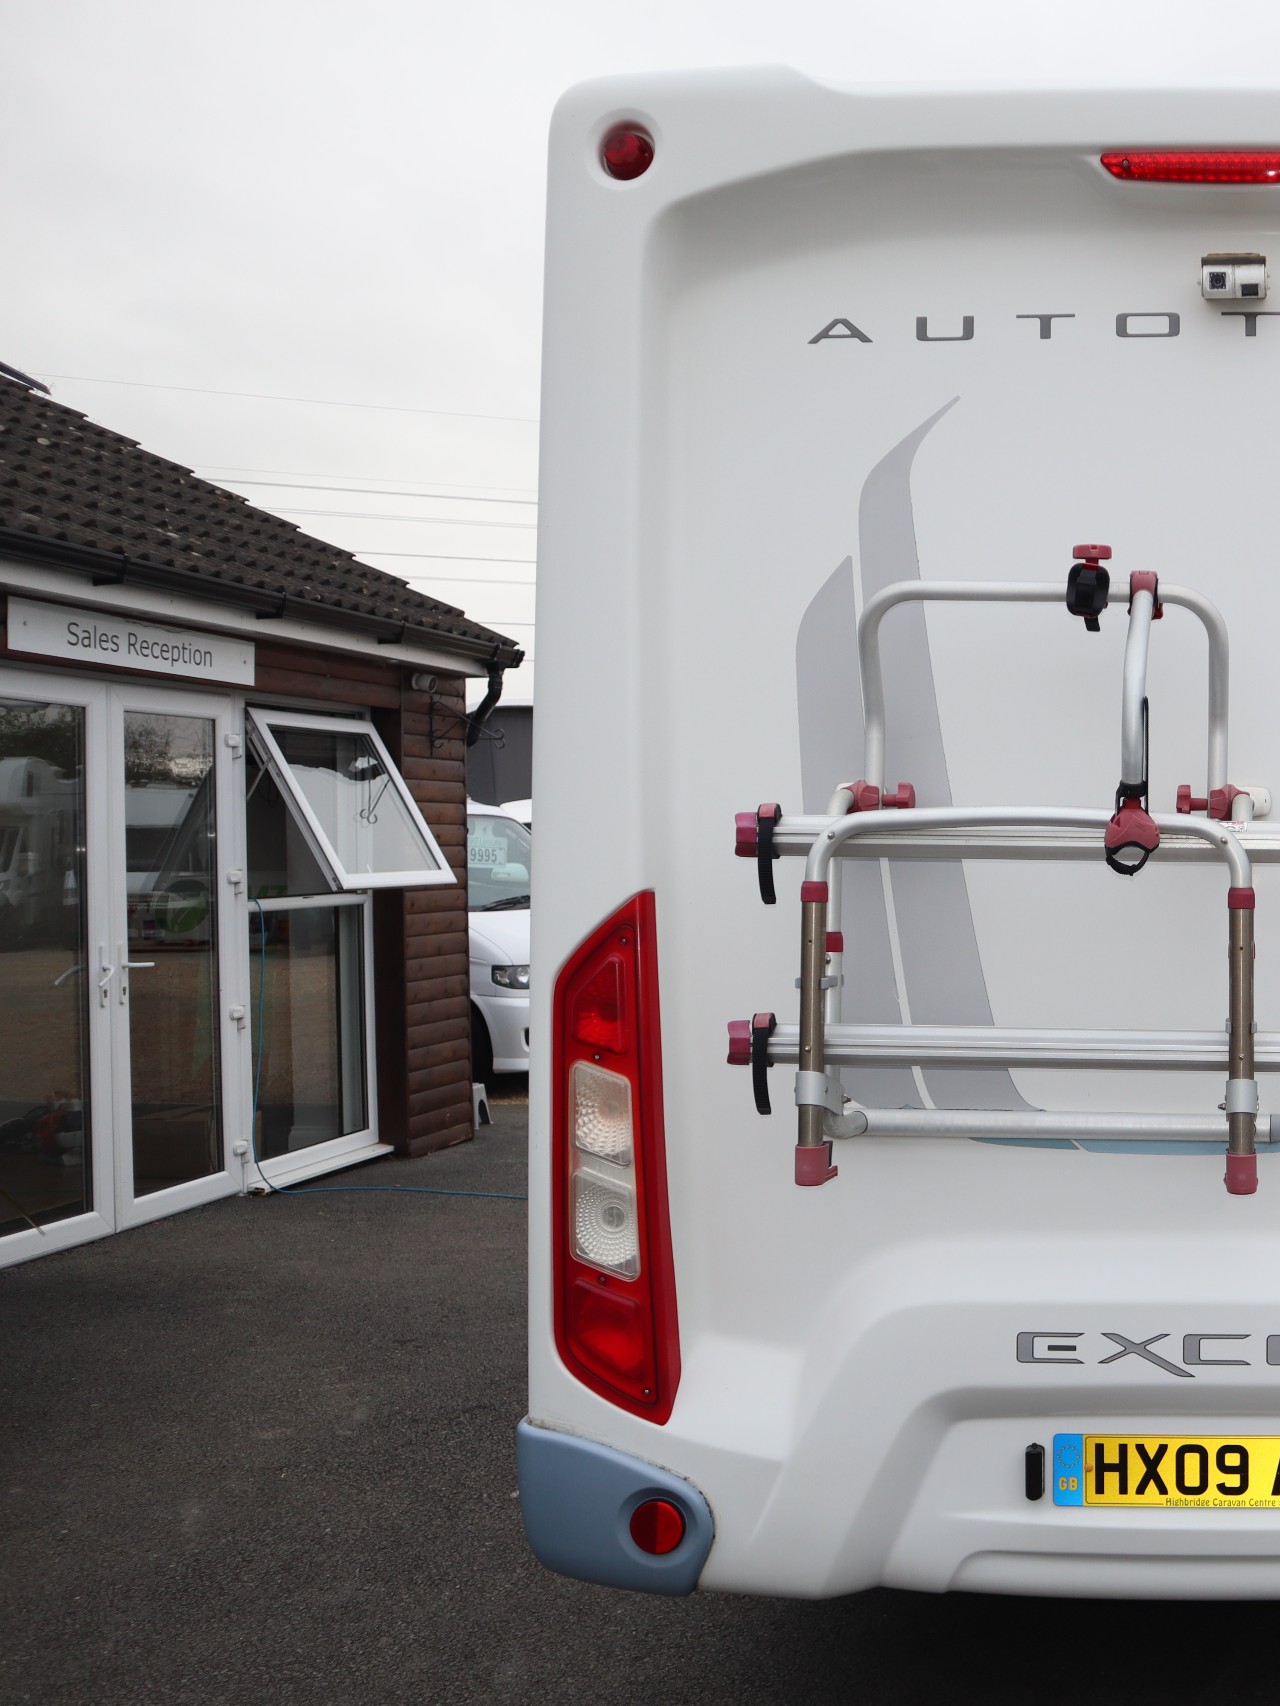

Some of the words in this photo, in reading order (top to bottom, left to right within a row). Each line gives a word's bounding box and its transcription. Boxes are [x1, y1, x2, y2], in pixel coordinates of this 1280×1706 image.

[66, 621, 121, 653] Sales
[127, 631, 214, 668] Reception
[1058, 1476, 1079, 1491] GB
[1094, 1442, 1250, 1496] HX09
[1165, 1497, 1210, 1507] Highbridge
[1212, 1498, 1247, 1508] Caravan
[1248, 1498, 1276, 1507] Centre
